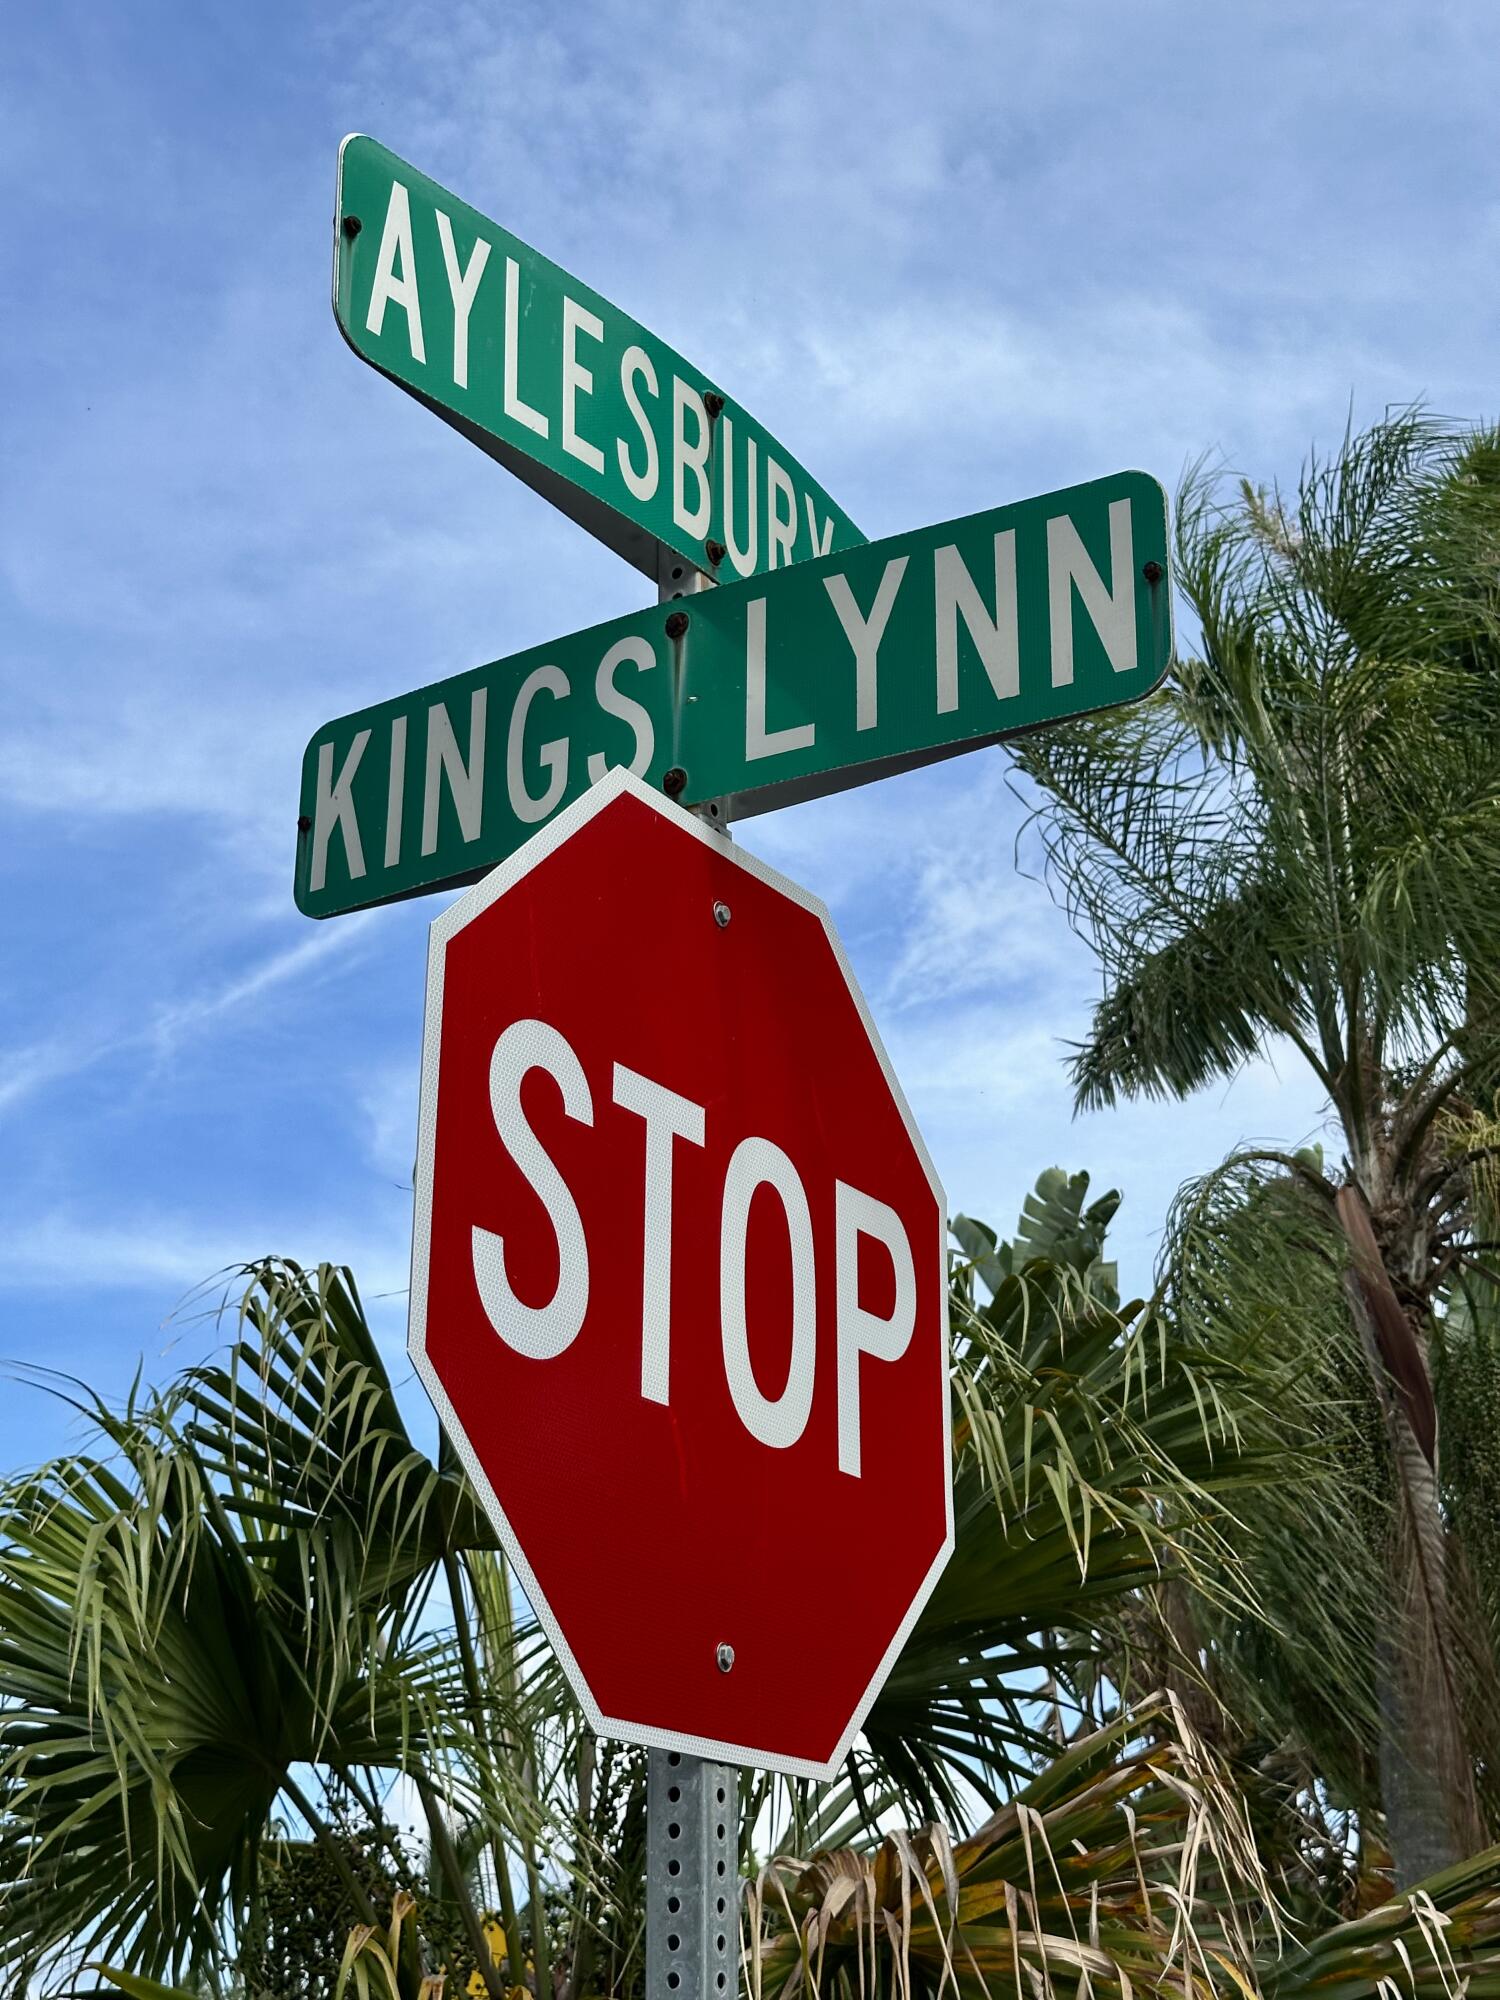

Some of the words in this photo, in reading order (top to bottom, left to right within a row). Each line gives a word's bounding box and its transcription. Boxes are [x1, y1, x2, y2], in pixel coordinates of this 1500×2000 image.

[310, 636, 657, 892] KINGS
[745, 497, 1138, 762] LYNN
[471, 1018, 917, 1479] STOP
